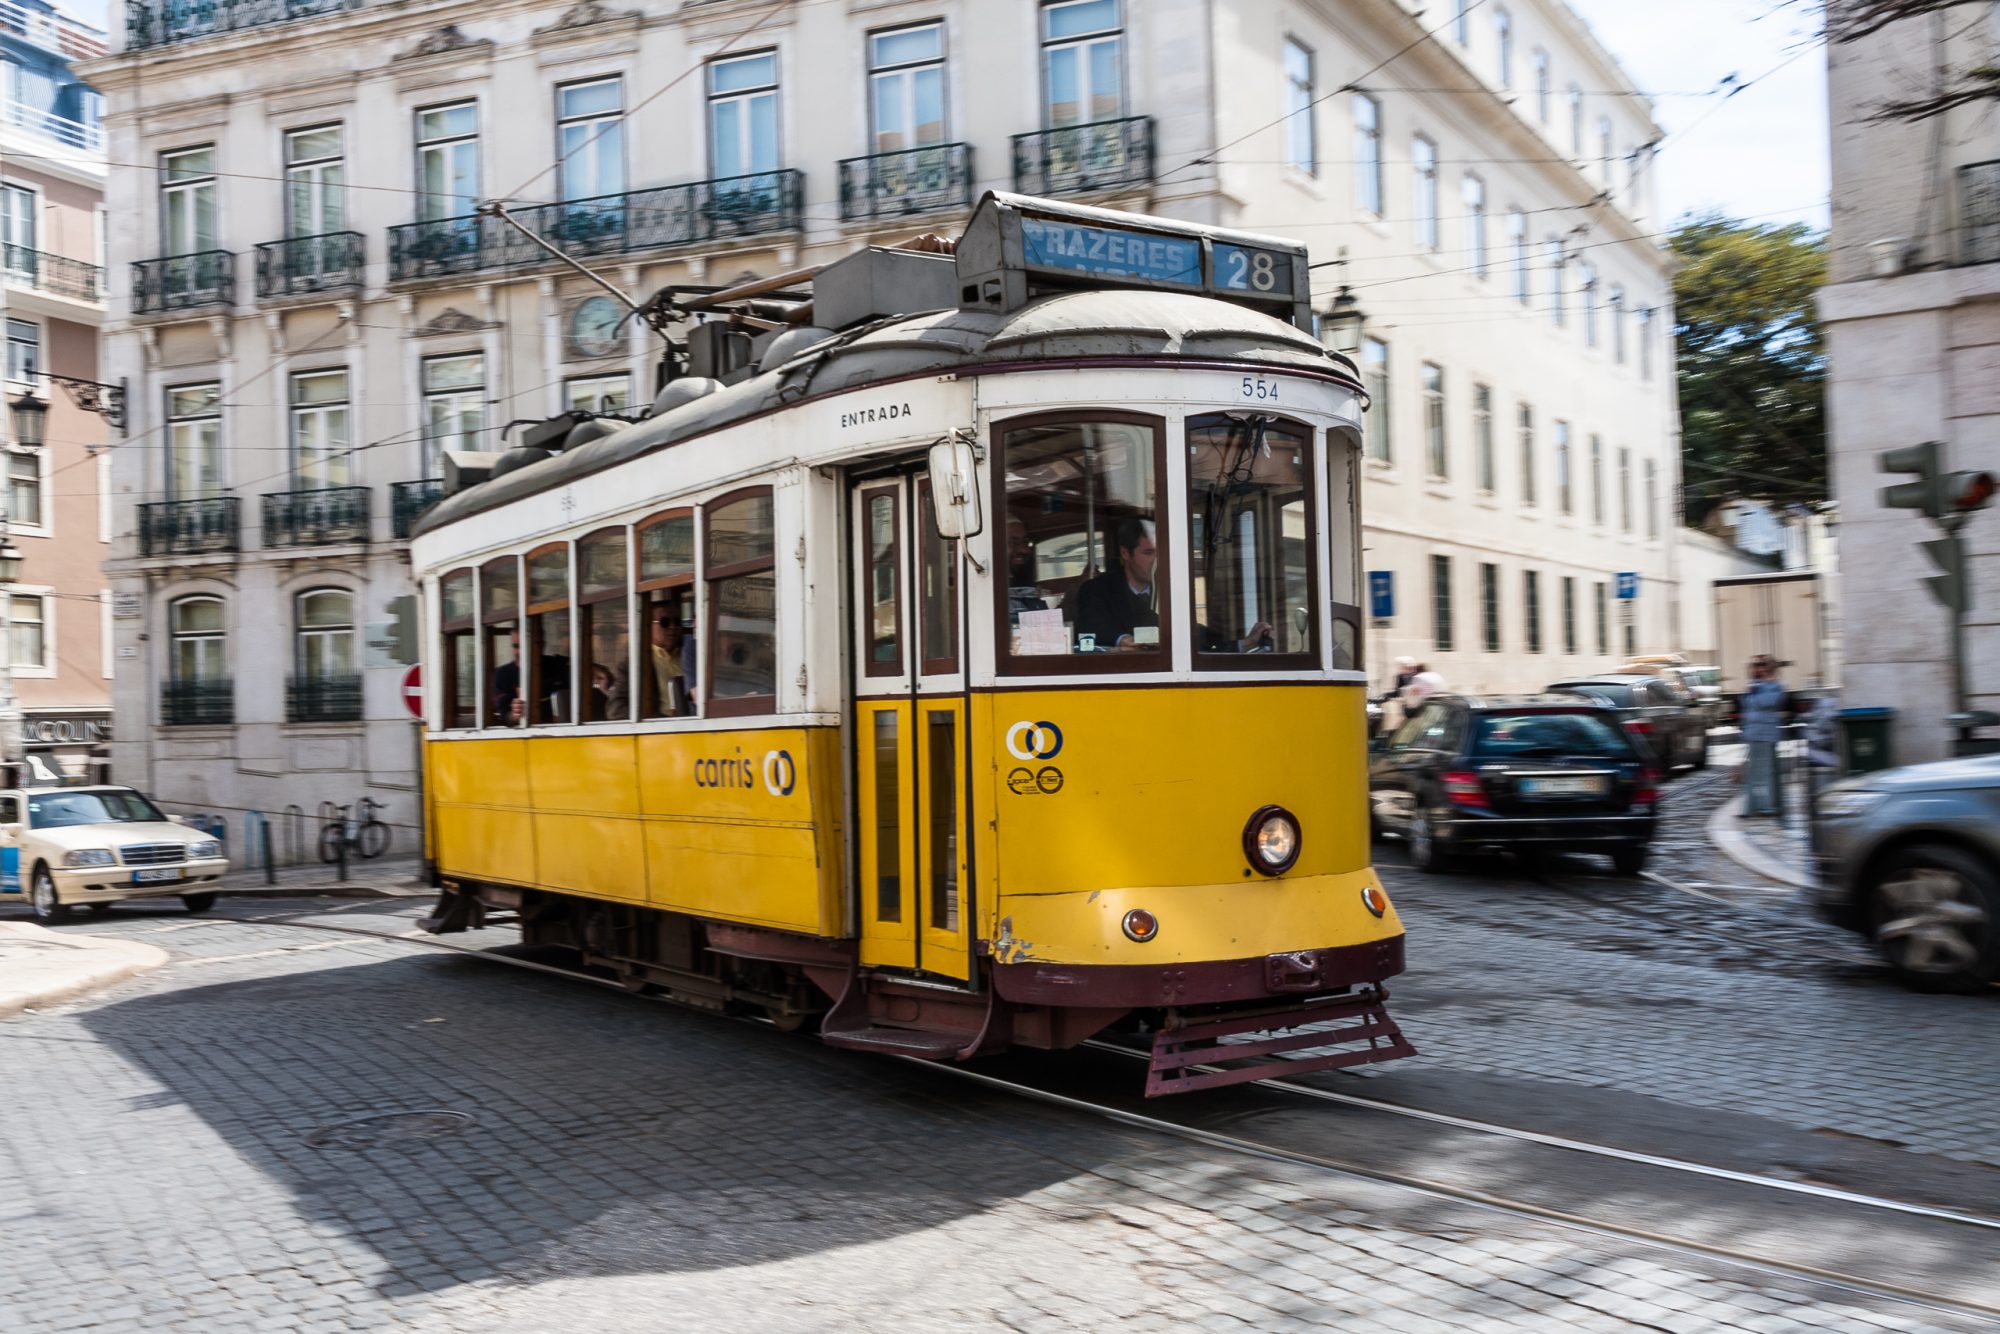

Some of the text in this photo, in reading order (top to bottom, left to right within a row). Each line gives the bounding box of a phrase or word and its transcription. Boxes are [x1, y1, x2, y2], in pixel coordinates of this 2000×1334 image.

[1023, 222, 1184, 272] PRAZERES
[1227, 250, 1275, 291] 28
[1242, 377, 1279, 401] 554
[841, 402, 912, 428] ENTRADA
[694, 745, 754, 789] carris
